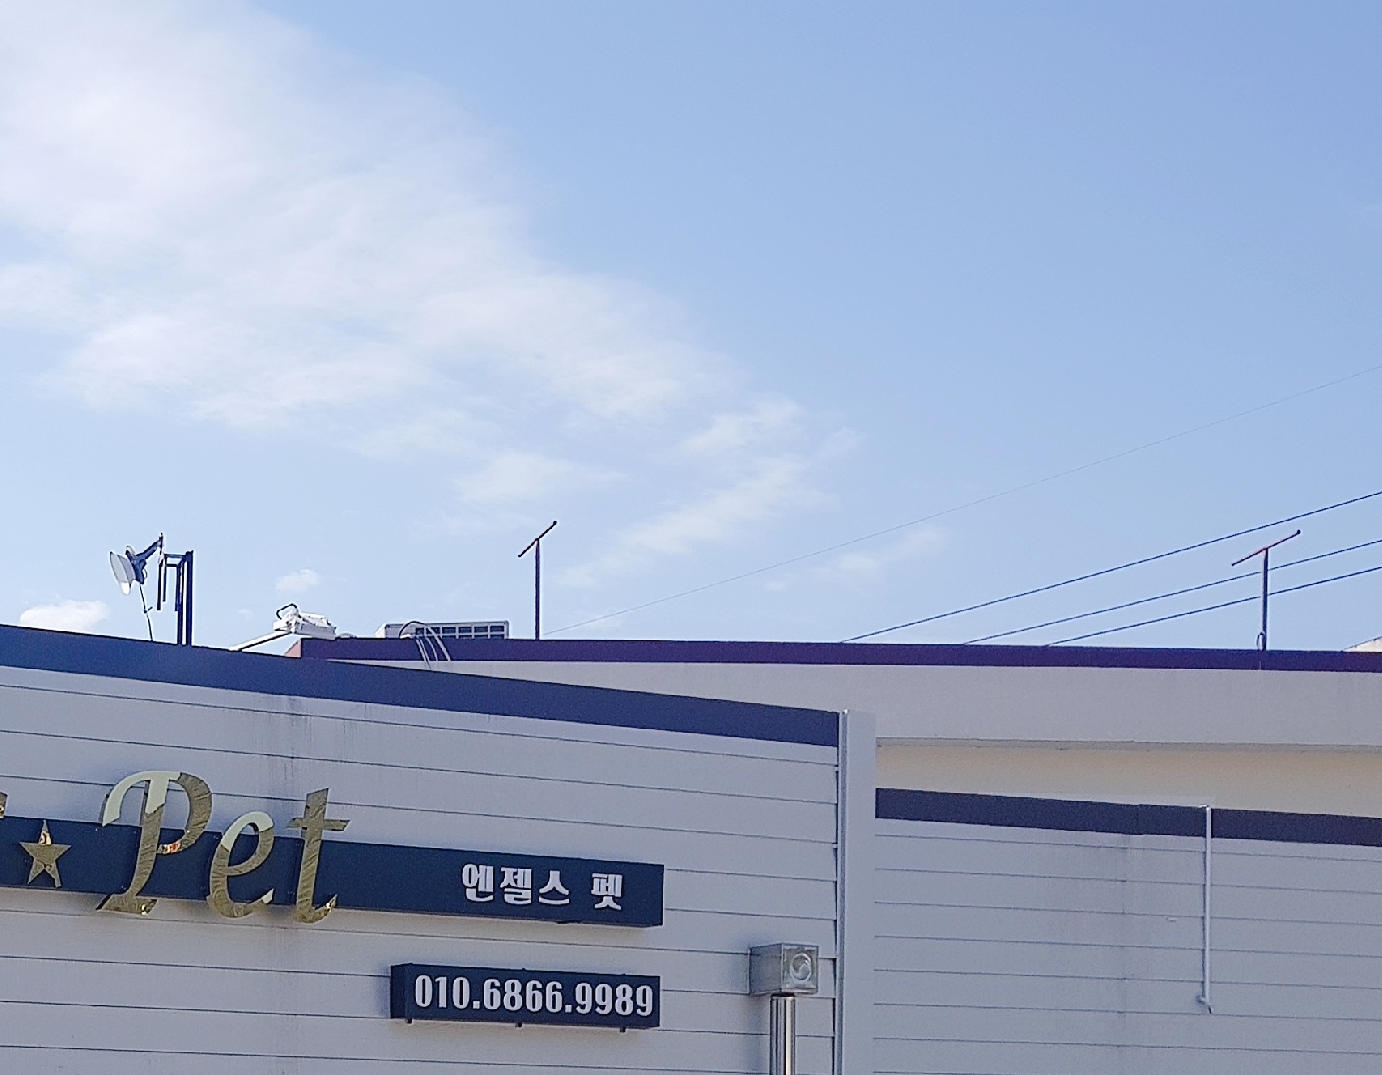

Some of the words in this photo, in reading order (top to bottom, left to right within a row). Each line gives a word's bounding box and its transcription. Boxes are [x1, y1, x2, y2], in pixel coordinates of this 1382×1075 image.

[96, 771, 350, 923] Pet
[462, 863, 570, 906] 엔젤스
[590, 872, 623, 911] 펫
[414, 974, 654, 1017] 010.6866.9989
